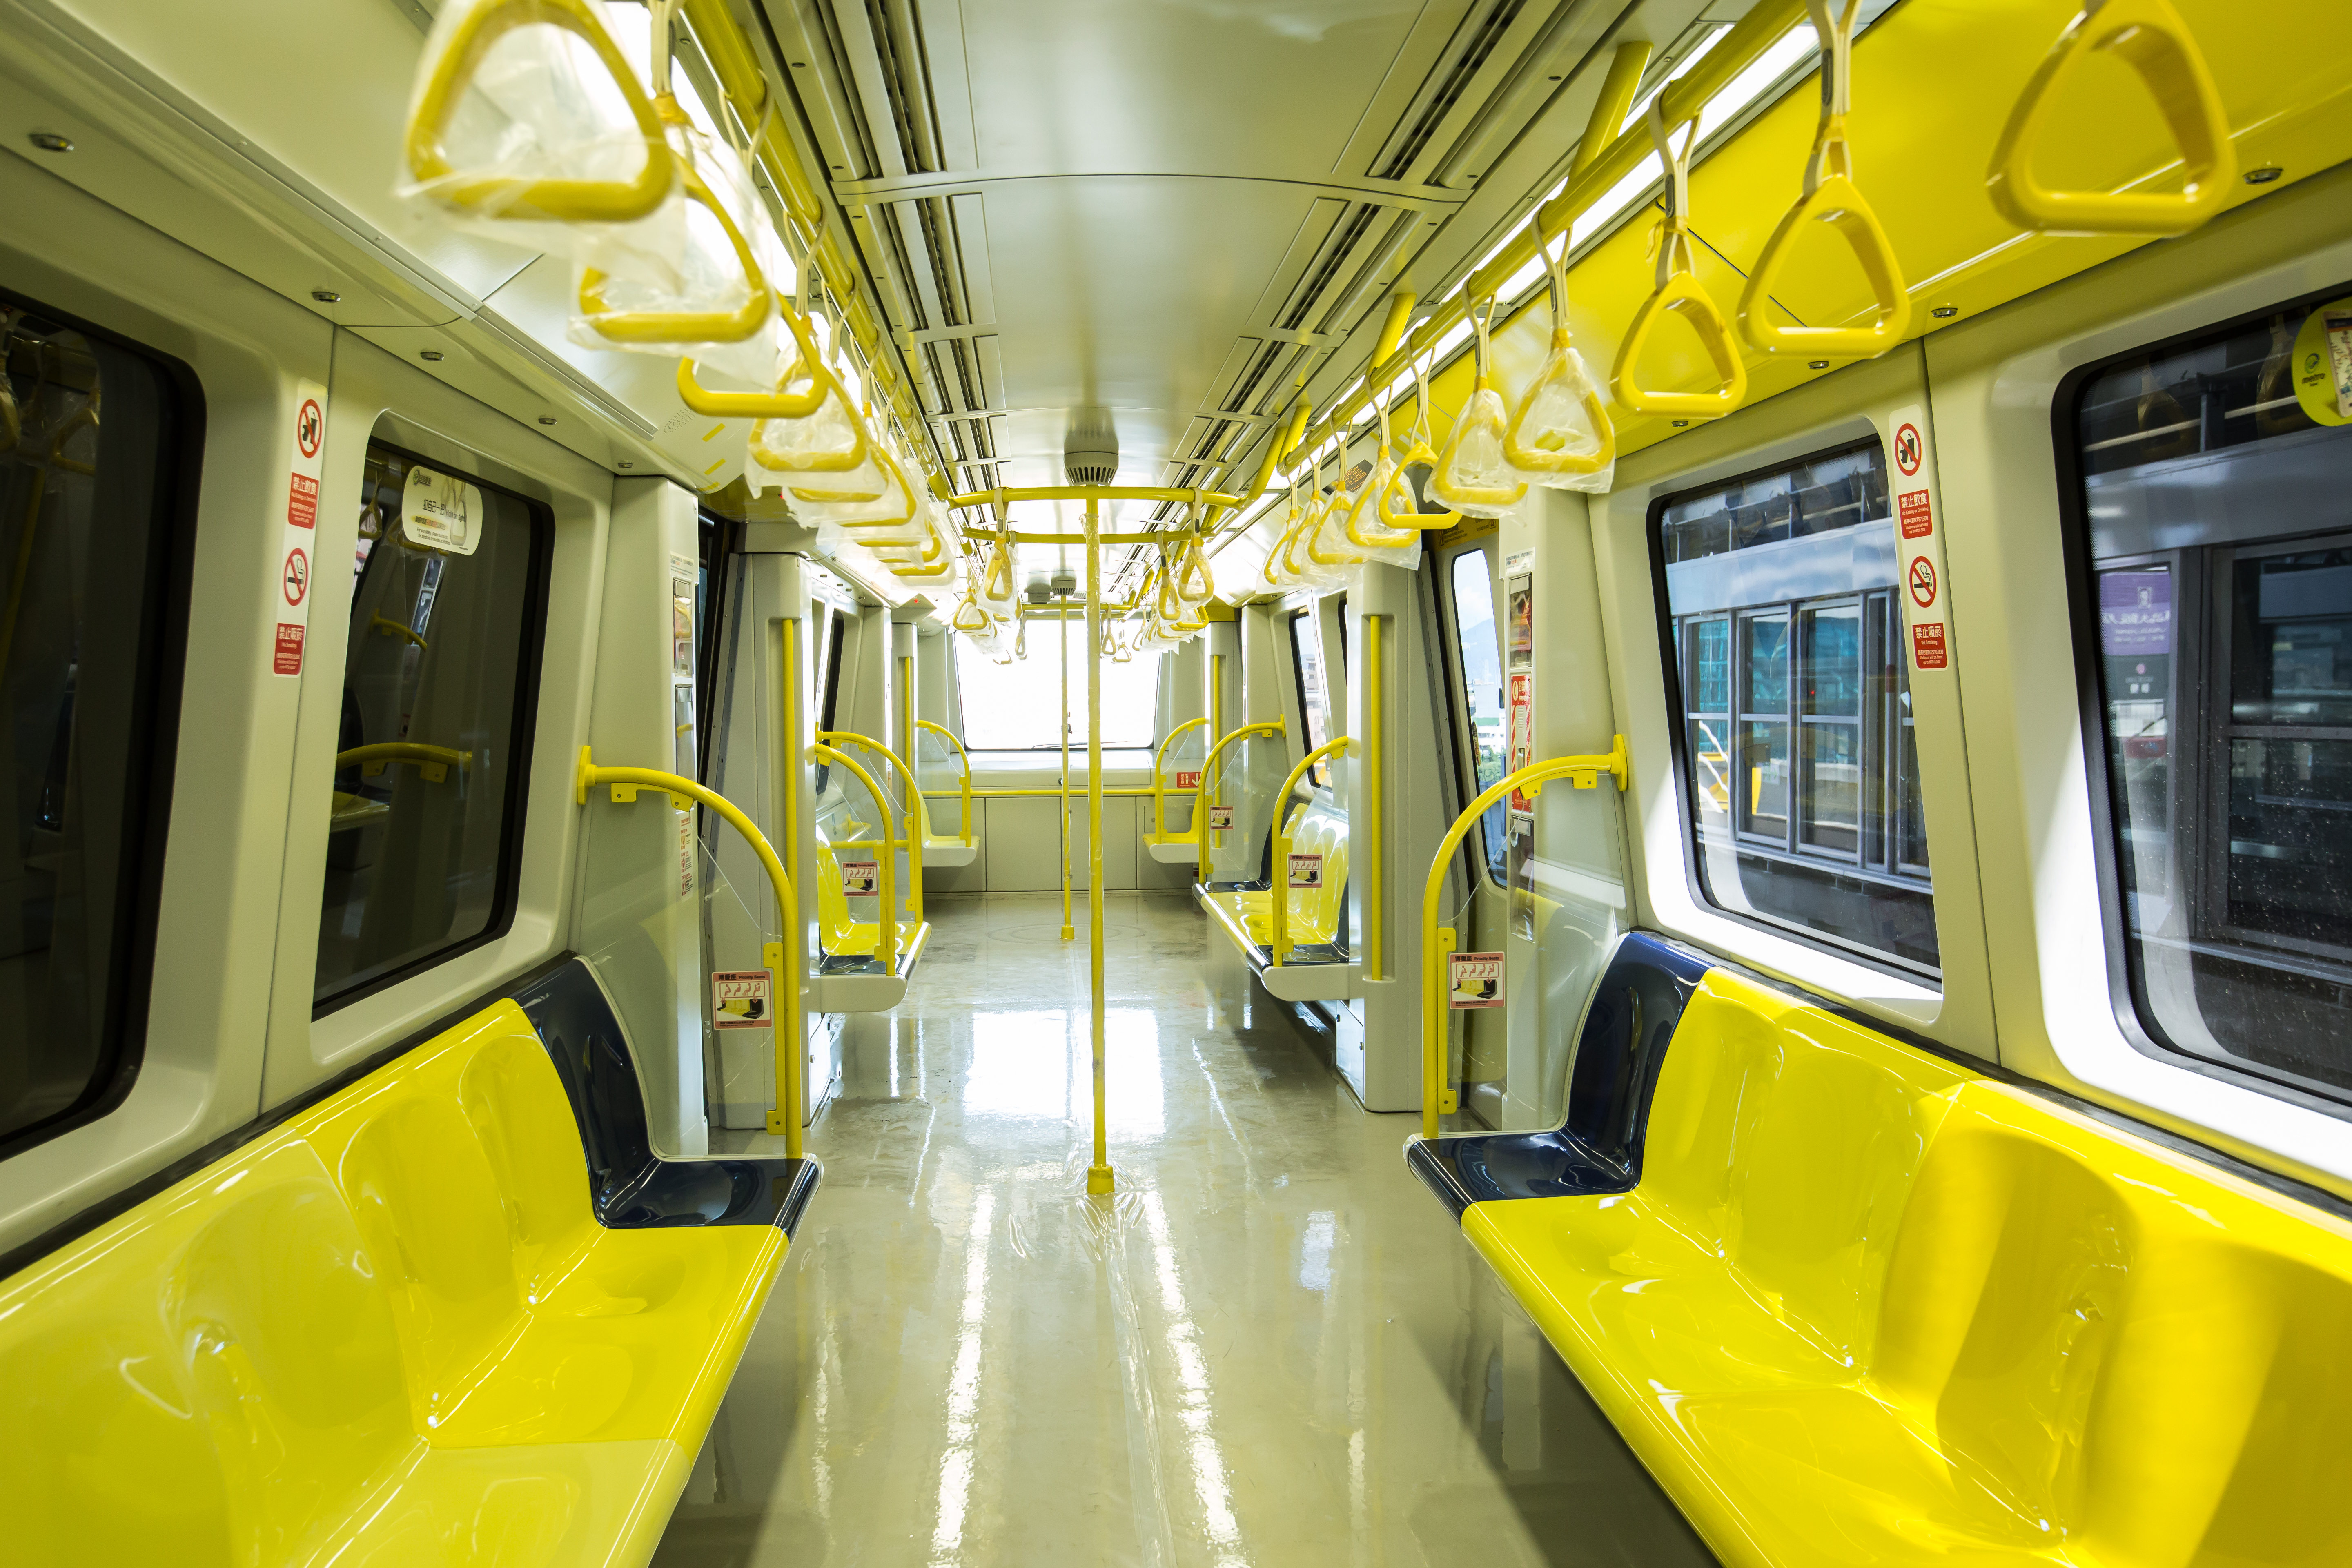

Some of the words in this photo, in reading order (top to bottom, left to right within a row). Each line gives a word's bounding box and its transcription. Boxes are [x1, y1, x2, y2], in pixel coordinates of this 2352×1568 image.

[292, 477, 317, 496] 禁止飲食
[1901, 492, 1927, 508] 禁止飲食
[279, 626, 303, 641] 禁止吸菸
[1915, 626, 1942, 639] 禁止吸菸
